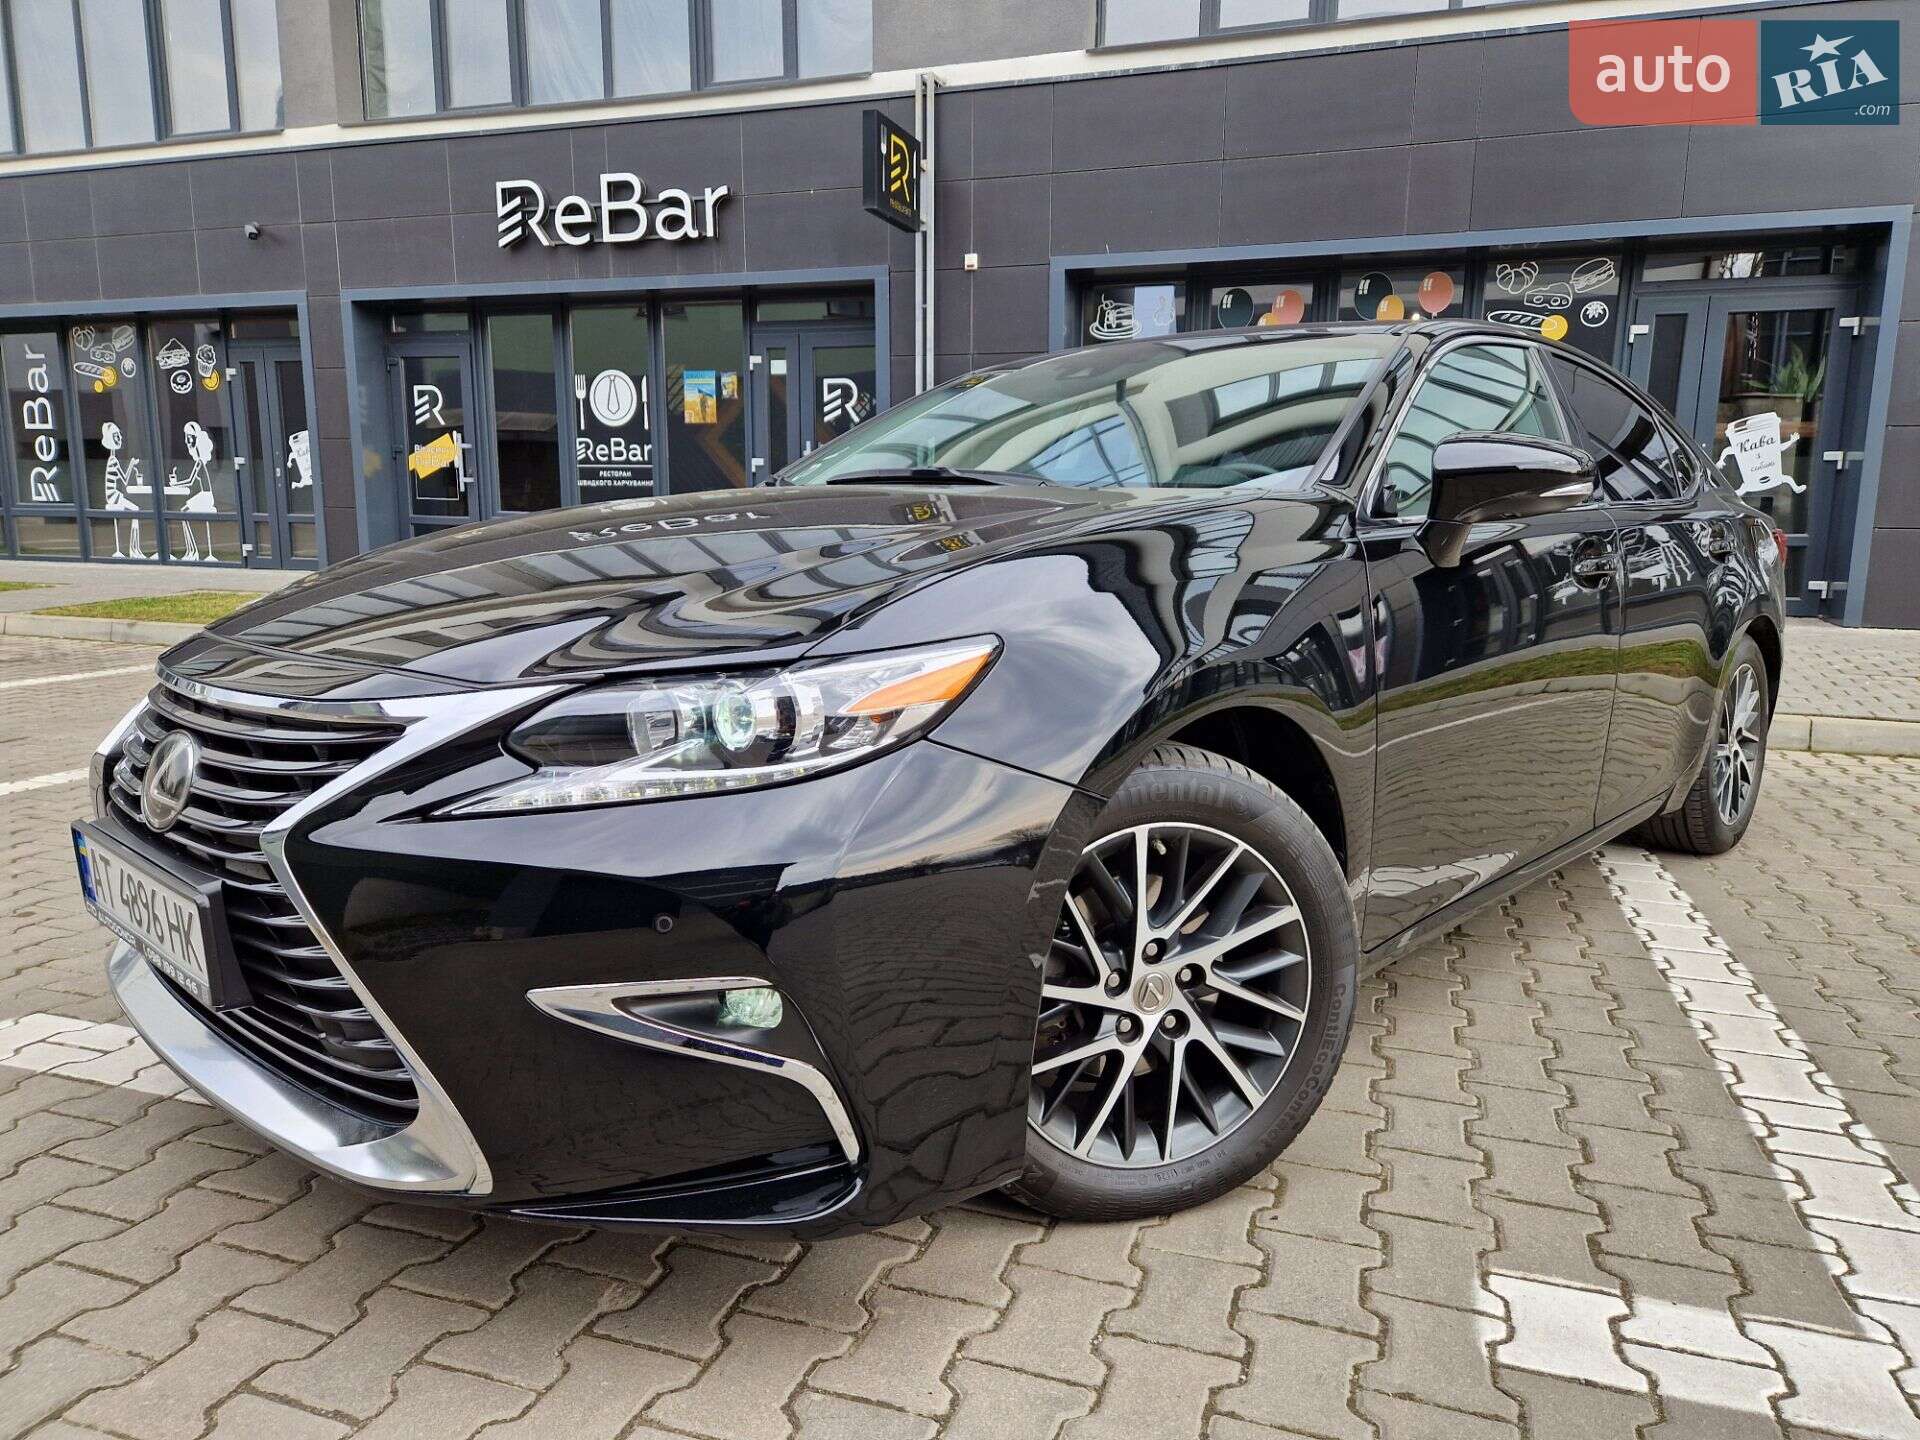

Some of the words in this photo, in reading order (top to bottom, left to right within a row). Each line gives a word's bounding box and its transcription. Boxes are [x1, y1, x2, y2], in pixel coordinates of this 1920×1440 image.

[496, 172, 731, 249] ReBar
[23, 343, 60, 502] ReBar
[576, 437, 653, 462] ReBar
[599, 470, 632, 478] РЕСТОРАН
[577, 479, 612, 487] ШВИДКОГО
[613, 479, 654, 487] ХАРЧУВАННЯ
[119, 867, 164, 946] 4896
[163, 895, 204, 972] HK
